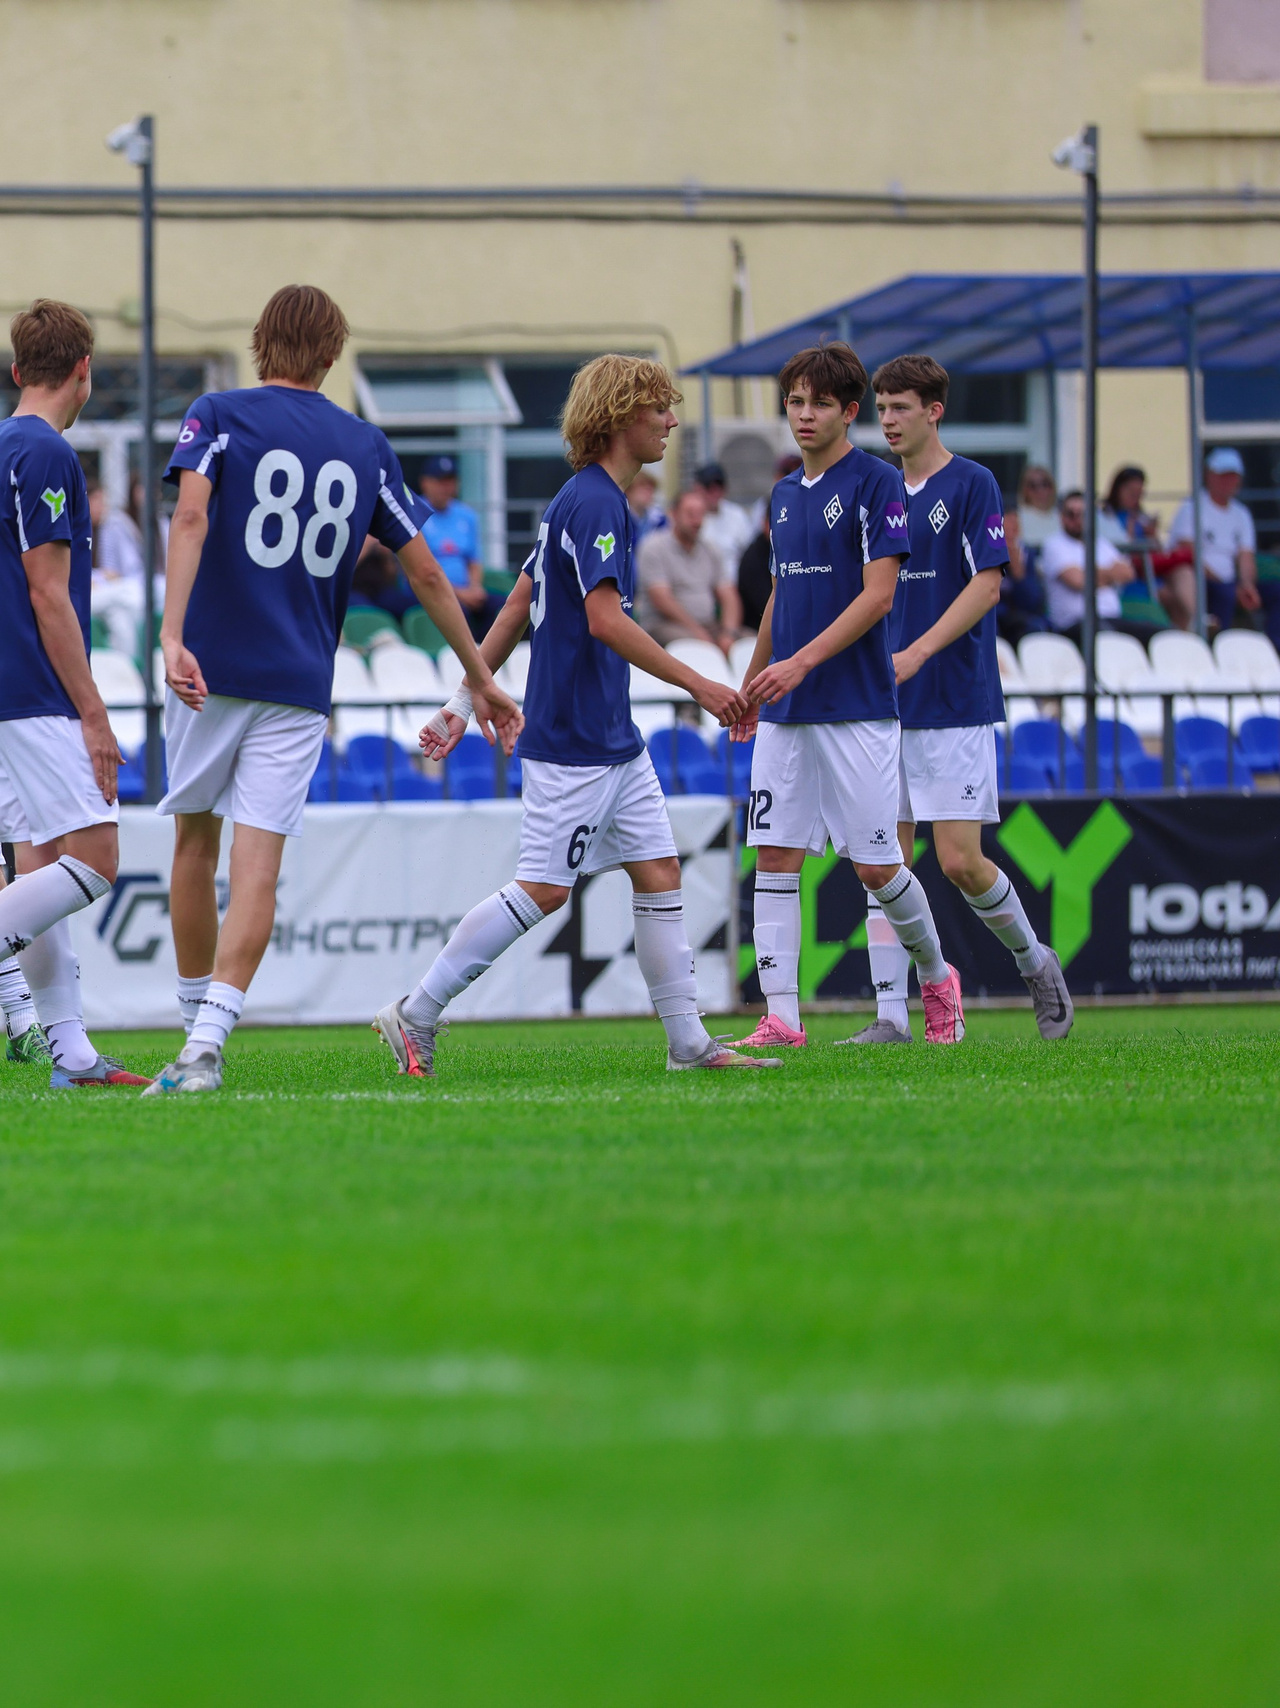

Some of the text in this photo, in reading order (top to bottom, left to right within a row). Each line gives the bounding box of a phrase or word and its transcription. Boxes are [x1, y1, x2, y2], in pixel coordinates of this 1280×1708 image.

[245, 448, 357, 578] 88
[750, 789, 773, 830] 12
[1246, 956, 1280, 980] ЛИГ
